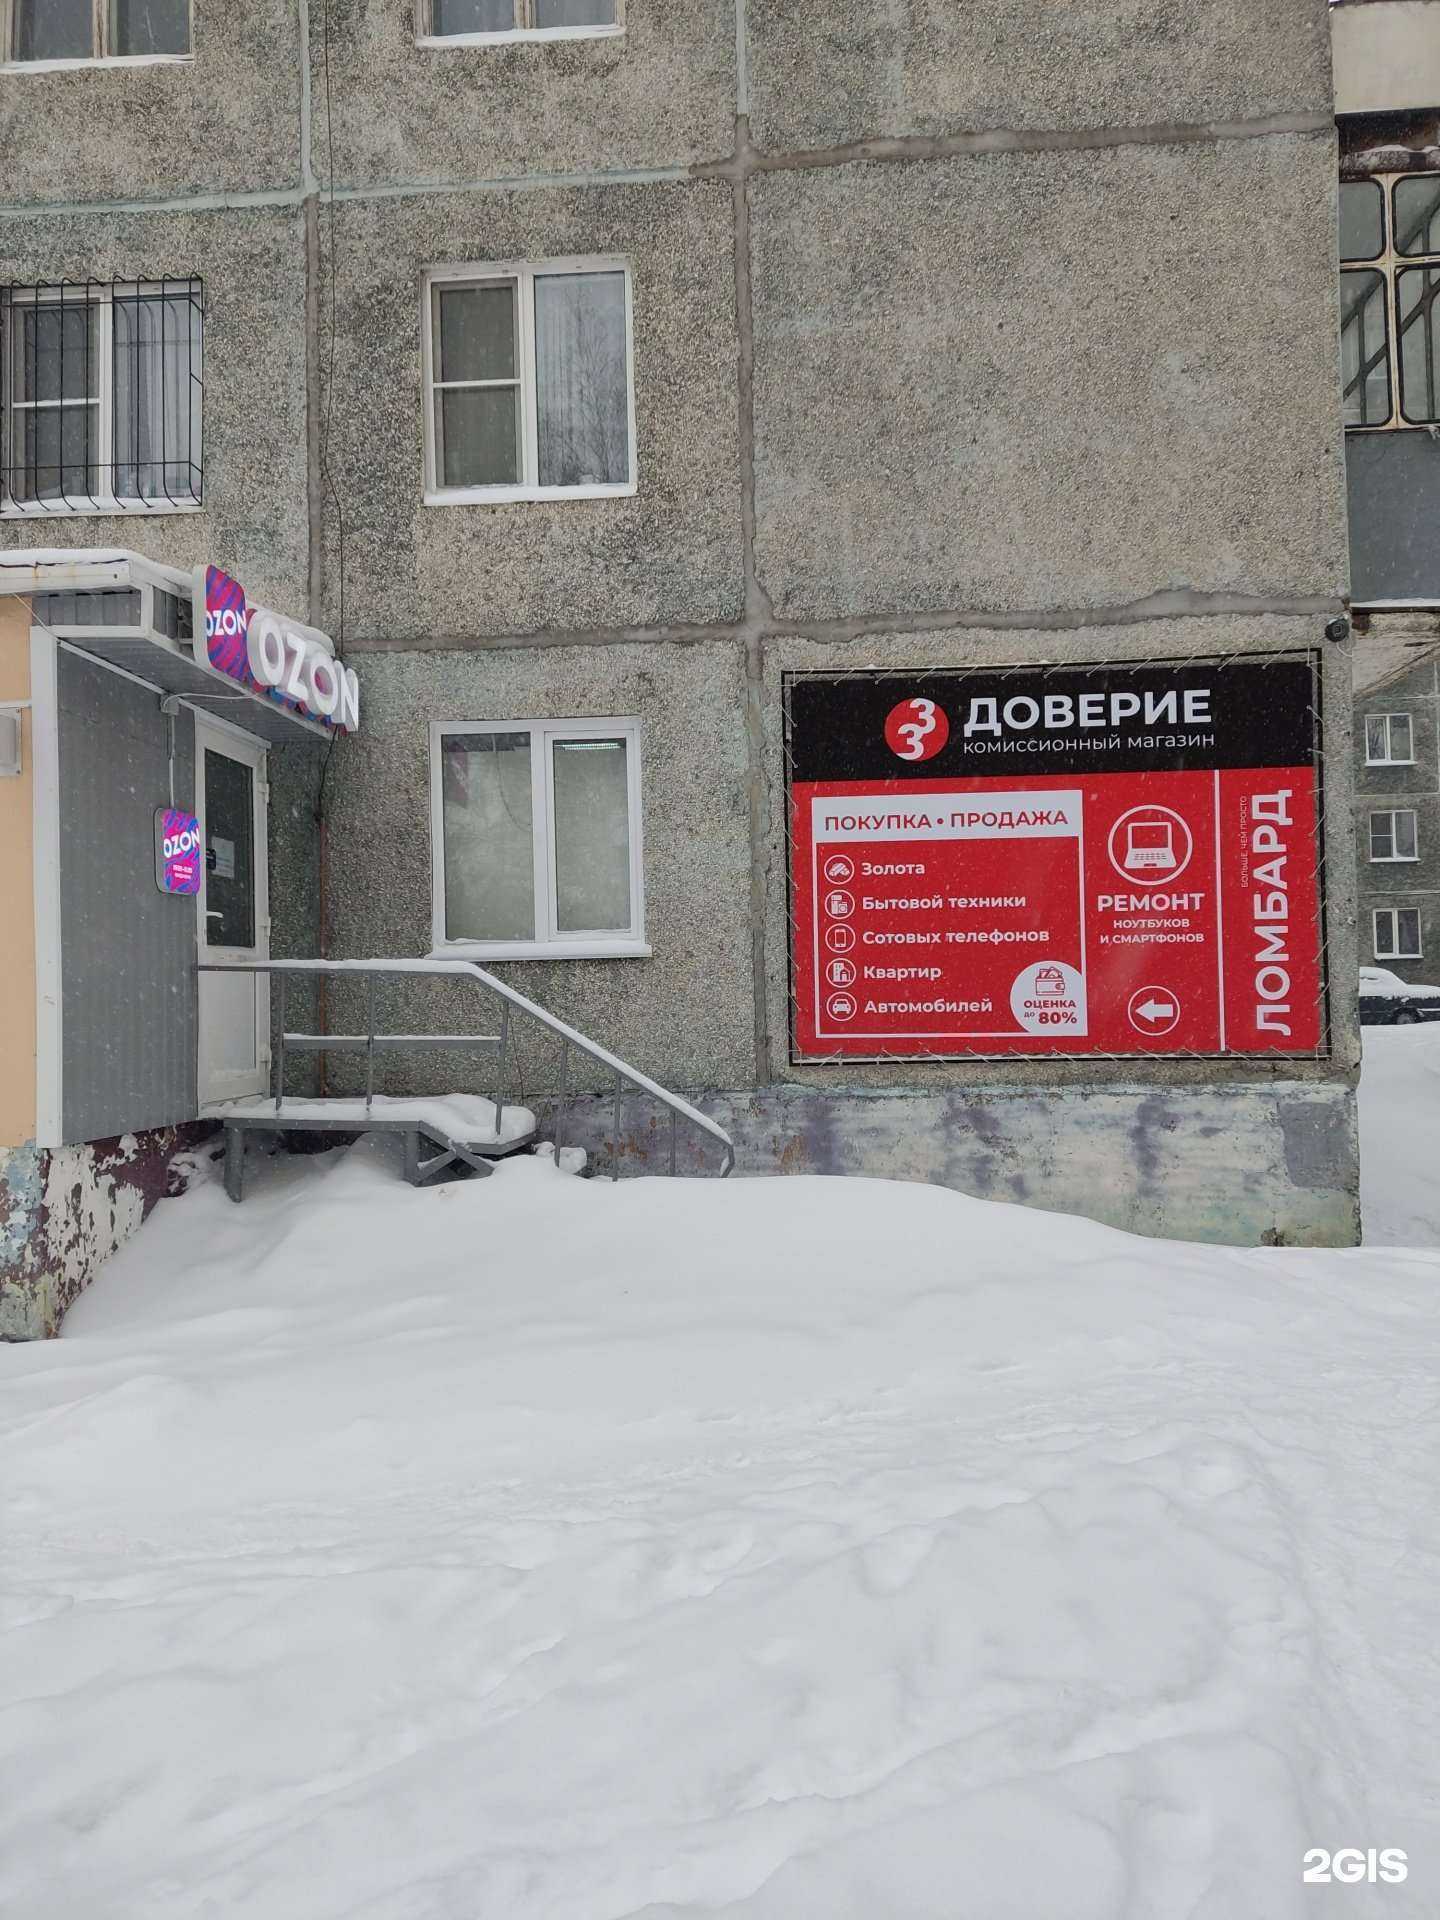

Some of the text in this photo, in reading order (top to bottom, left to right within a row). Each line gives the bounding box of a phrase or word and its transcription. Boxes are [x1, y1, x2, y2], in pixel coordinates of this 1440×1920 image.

[205, 610, 247, 637] OZON
[252, 613, 359, 732] OZON
[963, 689, 1212, 737] ДОВЕРИЕ
[963, 733, 1215, 754] комиссионный магазин
[824, 810, 1069, 831] ПОКУПКА ПРОДАЖА
[1239, 795, 1248, 831] ПРОСТО
[163, 828, 200, 858] OZON
[861, 862, 926, 876] Золота
[862, 895, 1027, 910] Бытовой техники
[1097, 893, 1206, 912] РЕМОНТ
[1251, 789, 1294, 1037] ЛОМБАРД
[1113, 918, 1191, 929] НОУТБУКОВ
[862, 929, 1050, 944] Сотовых телефонов
[1100, 933, 1205, 944] И СМАРТФОНОВ
[863, 966, 942, 981] Квартир
[864, 998, 993, 1014] Автомобилей
[1023, 1000, 1077, 1010] ОЦЕНКА
[1038, 1011, 1078, 1025] 80%
